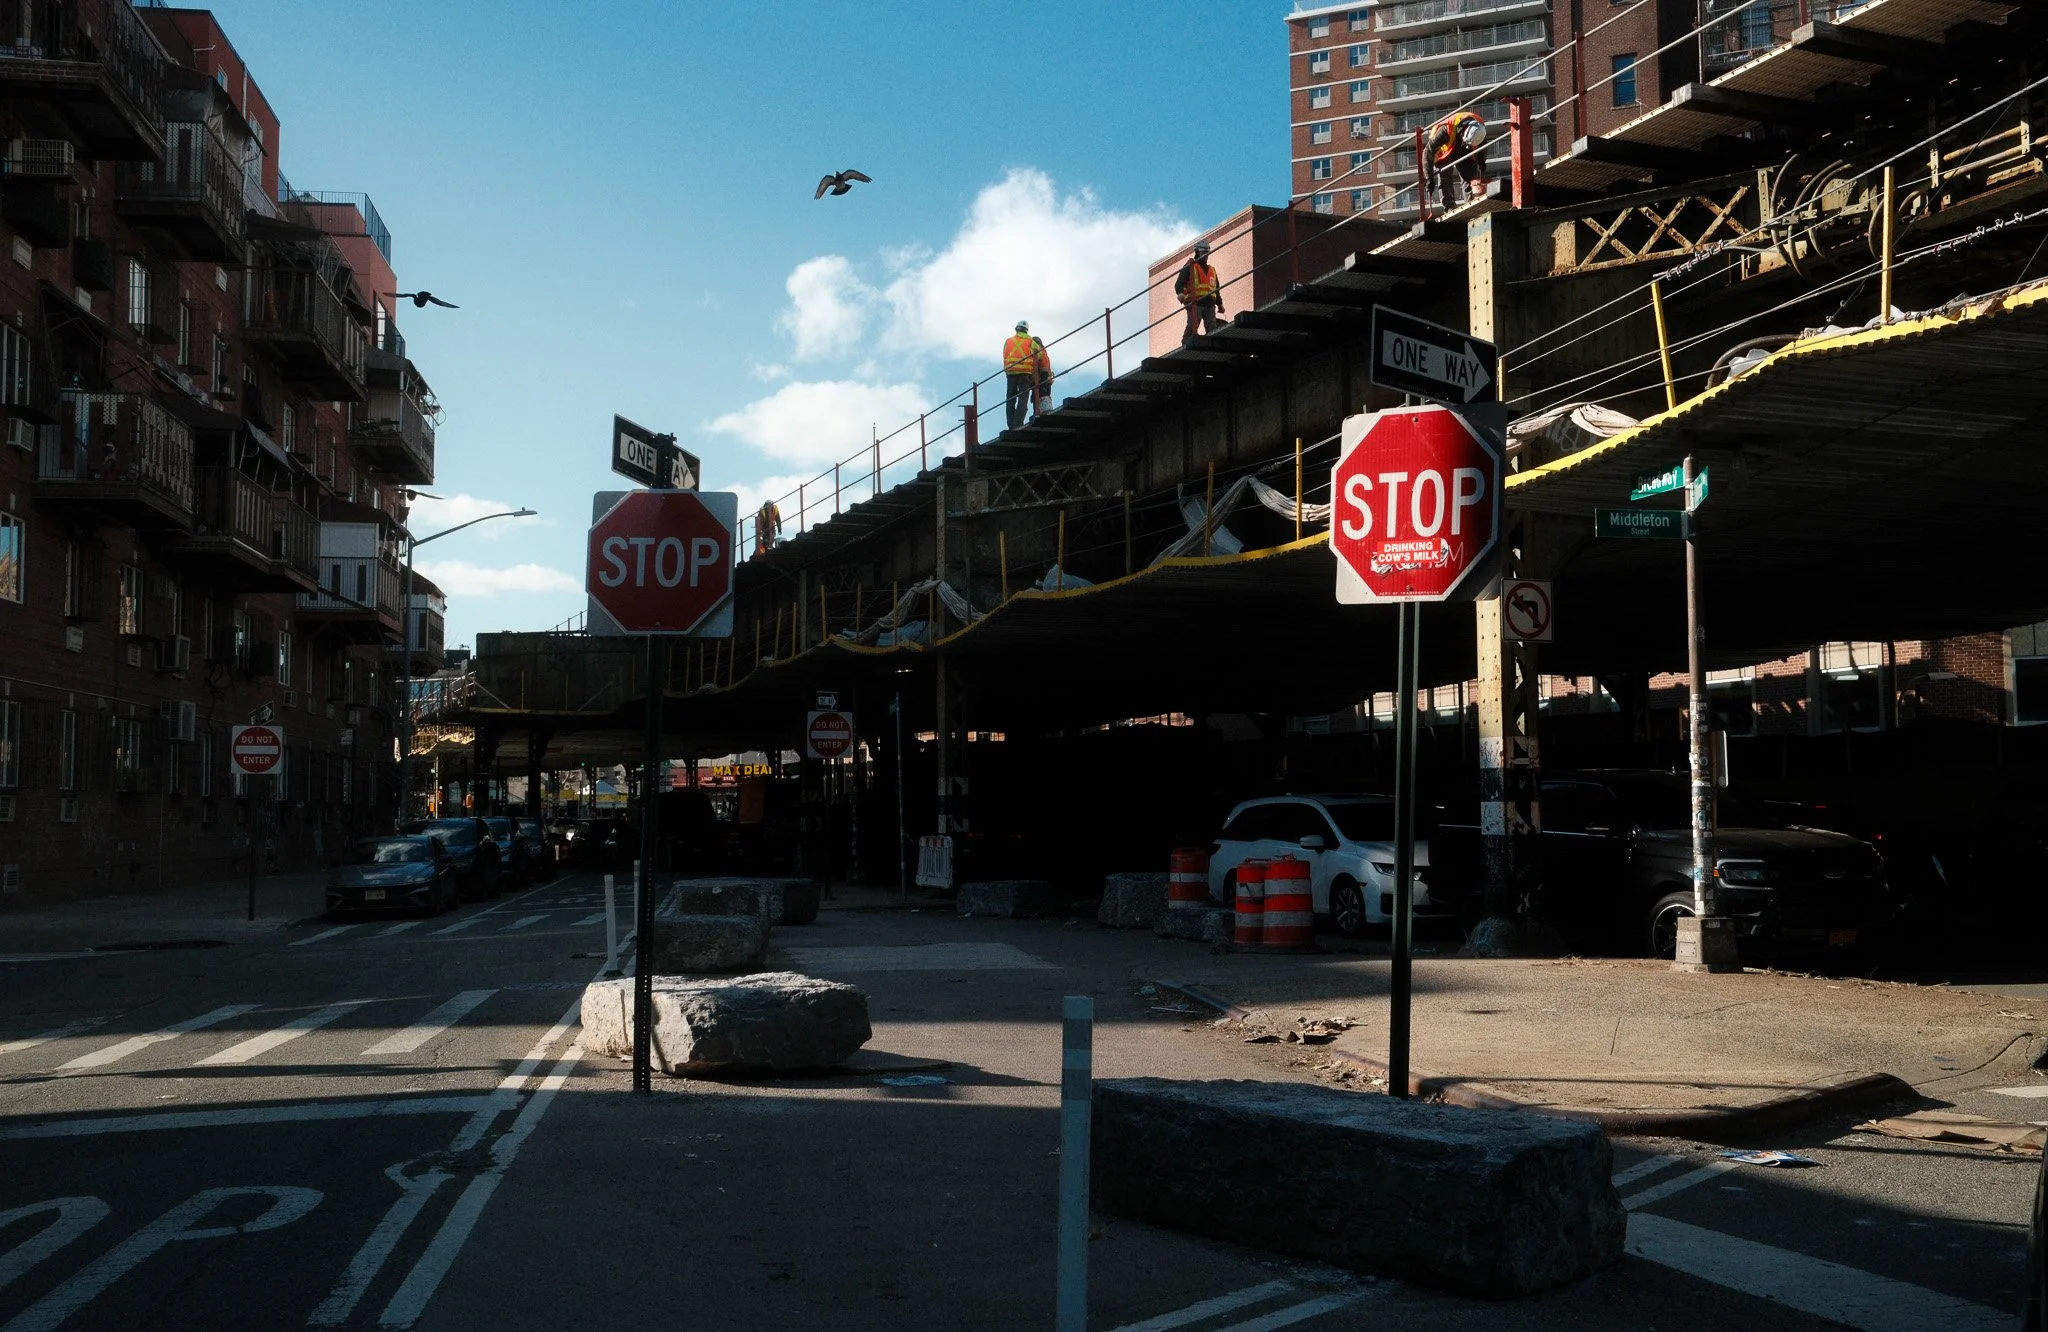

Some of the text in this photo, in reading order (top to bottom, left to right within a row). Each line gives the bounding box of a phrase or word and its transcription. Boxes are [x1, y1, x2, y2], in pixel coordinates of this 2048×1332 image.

[1393, 337, 1428, 373] ONE
[1445, 353, 1480, 388] WAY
[628, 440, 689, 488] ONE AY
[1637, 469, 1678, 494] Broadway
[1341, 466, 1486, 541] STOP
[1609, 511, 1670, 528] Middleton
[1630, 527, 1651, 536] Street
[1383, 542, 1434, 553] DRINKING
[599, 536, 720, 588] STOP
[1378, 550, 1439, 563] COW'S MILK
[816, 721, 845, 729] DO NOT
[241, 735, 273, 744] DO NOT
[817, 740, 842, 749] ENTER
[243, 756, 271, 765] ENTER
[713, 765, 741, 776] MAX
